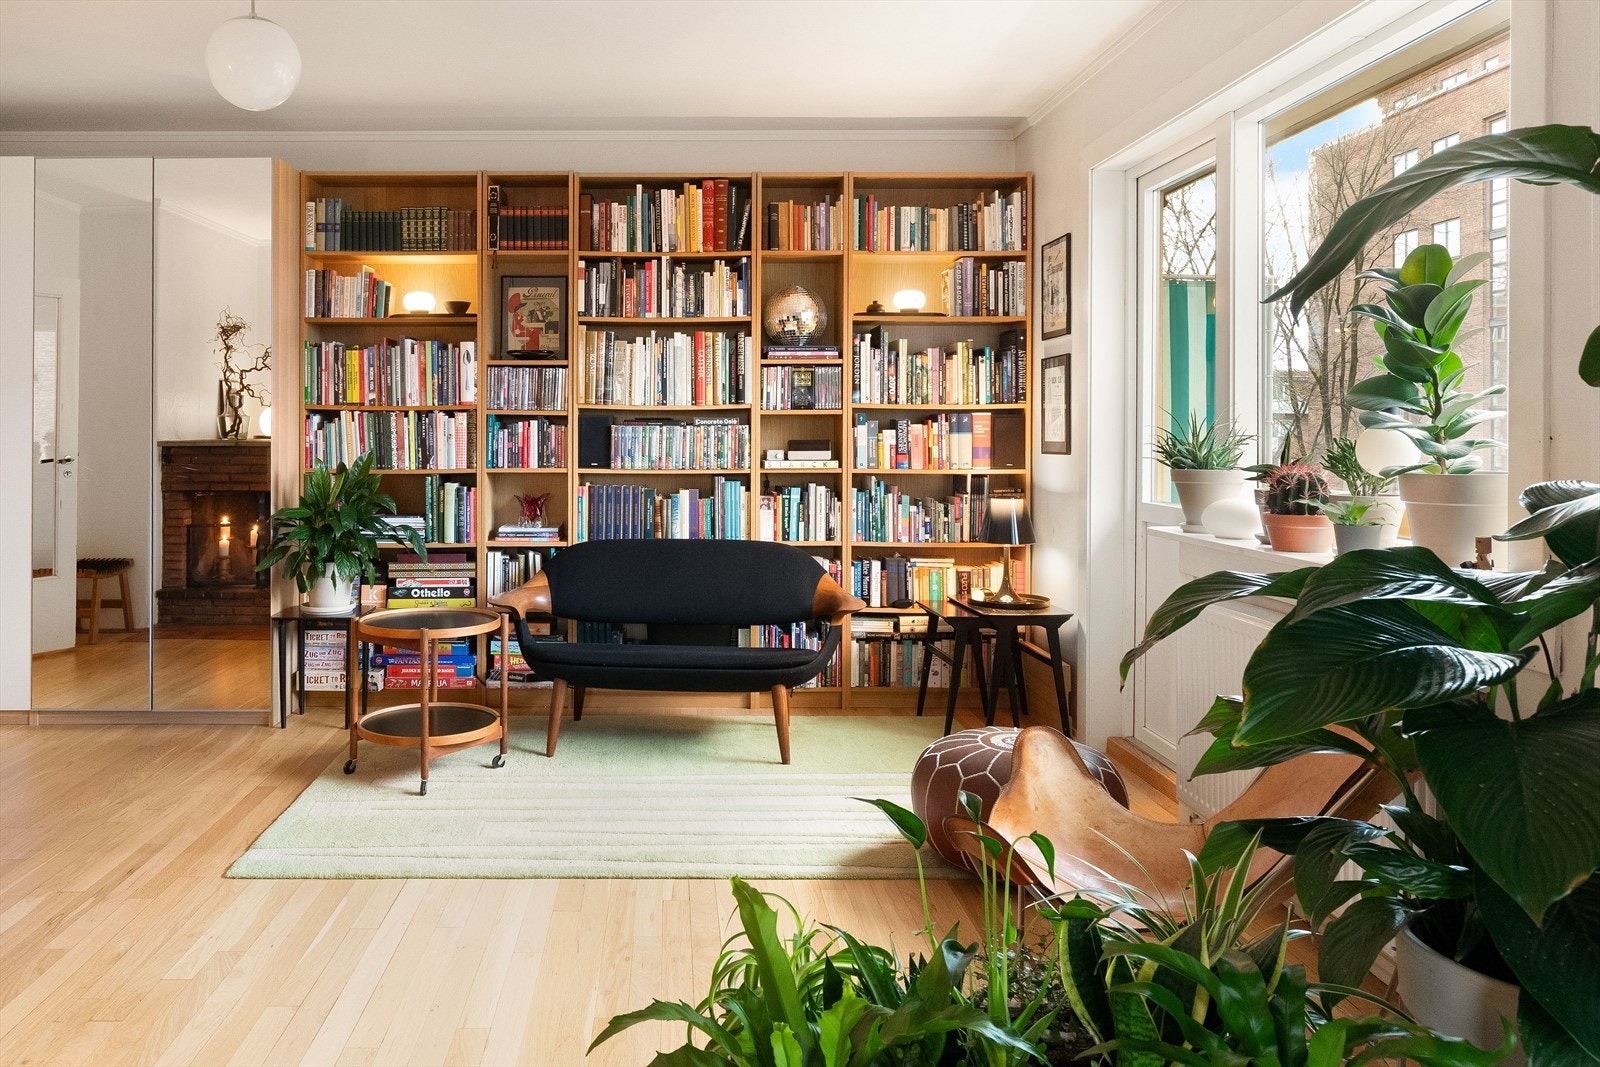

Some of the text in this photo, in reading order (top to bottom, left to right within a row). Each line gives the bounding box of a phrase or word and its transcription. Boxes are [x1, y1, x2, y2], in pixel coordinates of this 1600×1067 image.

[1018, 349, 1026, 394] ASTRONOMICA
[411, 588, 451, 598] Othello
[305, 632, 330, 641] TICKET
[304, 650, 319, 659] ZUG
[304, 674, 330, 684] ICKET
